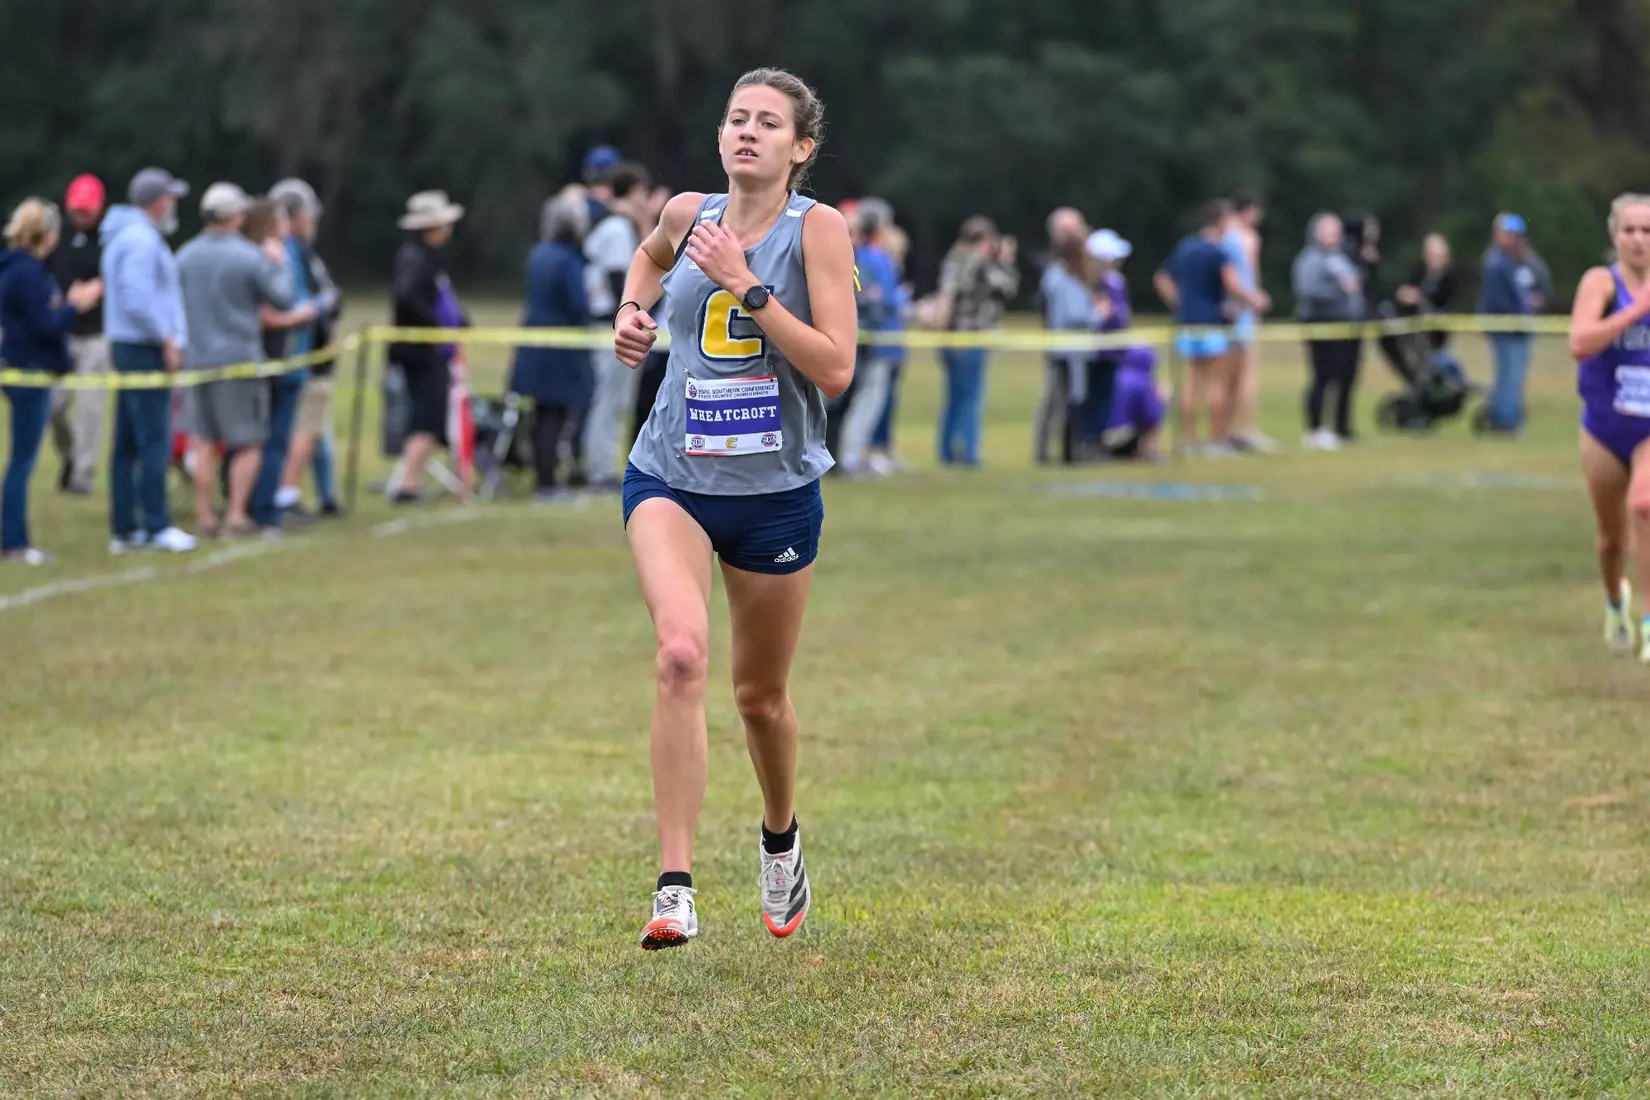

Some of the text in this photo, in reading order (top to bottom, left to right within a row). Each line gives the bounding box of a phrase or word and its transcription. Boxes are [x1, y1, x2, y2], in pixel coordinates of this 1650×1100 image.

[698, 285, 774, 362] C
[741, 384, 775, 392] CONFERENCE
[689, 406, 776, 422] WHEATCROFT
[774, 554, 799, 563] adidas
